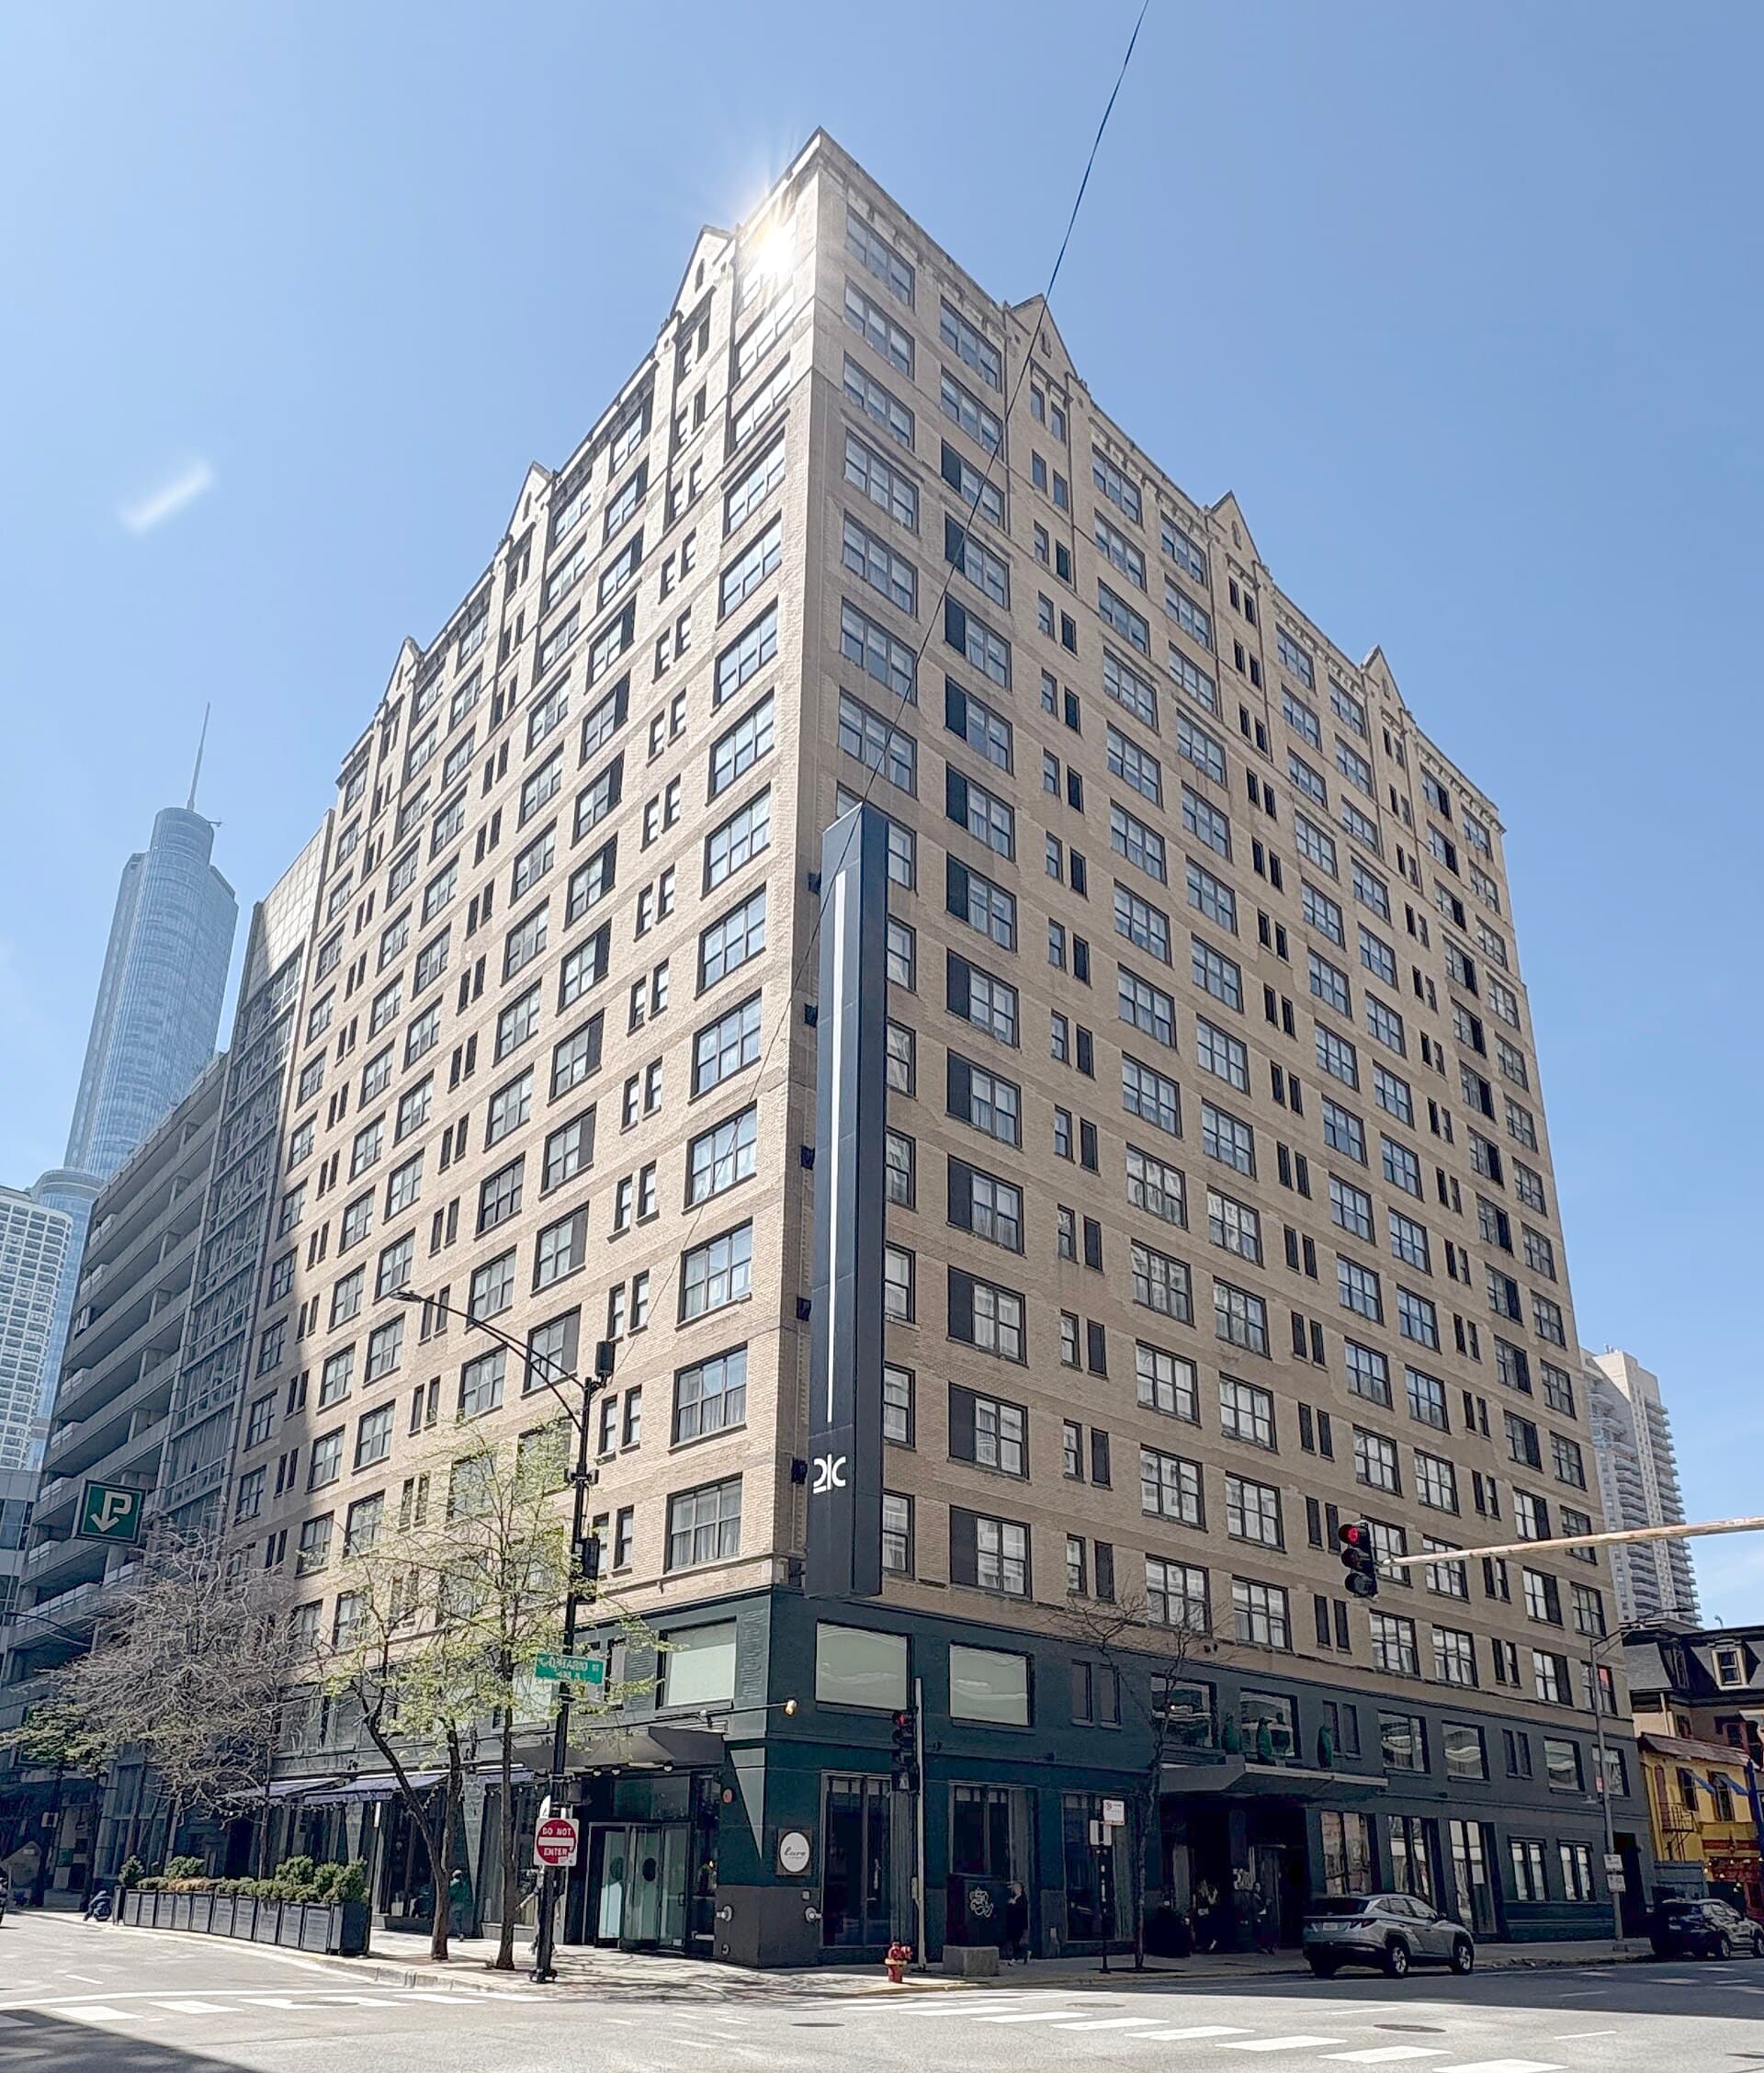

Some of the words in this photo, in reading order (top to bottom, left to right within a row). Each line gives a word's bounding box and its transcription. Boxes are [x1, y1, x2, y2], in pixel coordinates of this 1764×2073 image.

[542, 1827, 553, 1835] DO
[557, 1828, 571, 1836] NOT
[543, 1847, 568, 1856] ENTER
